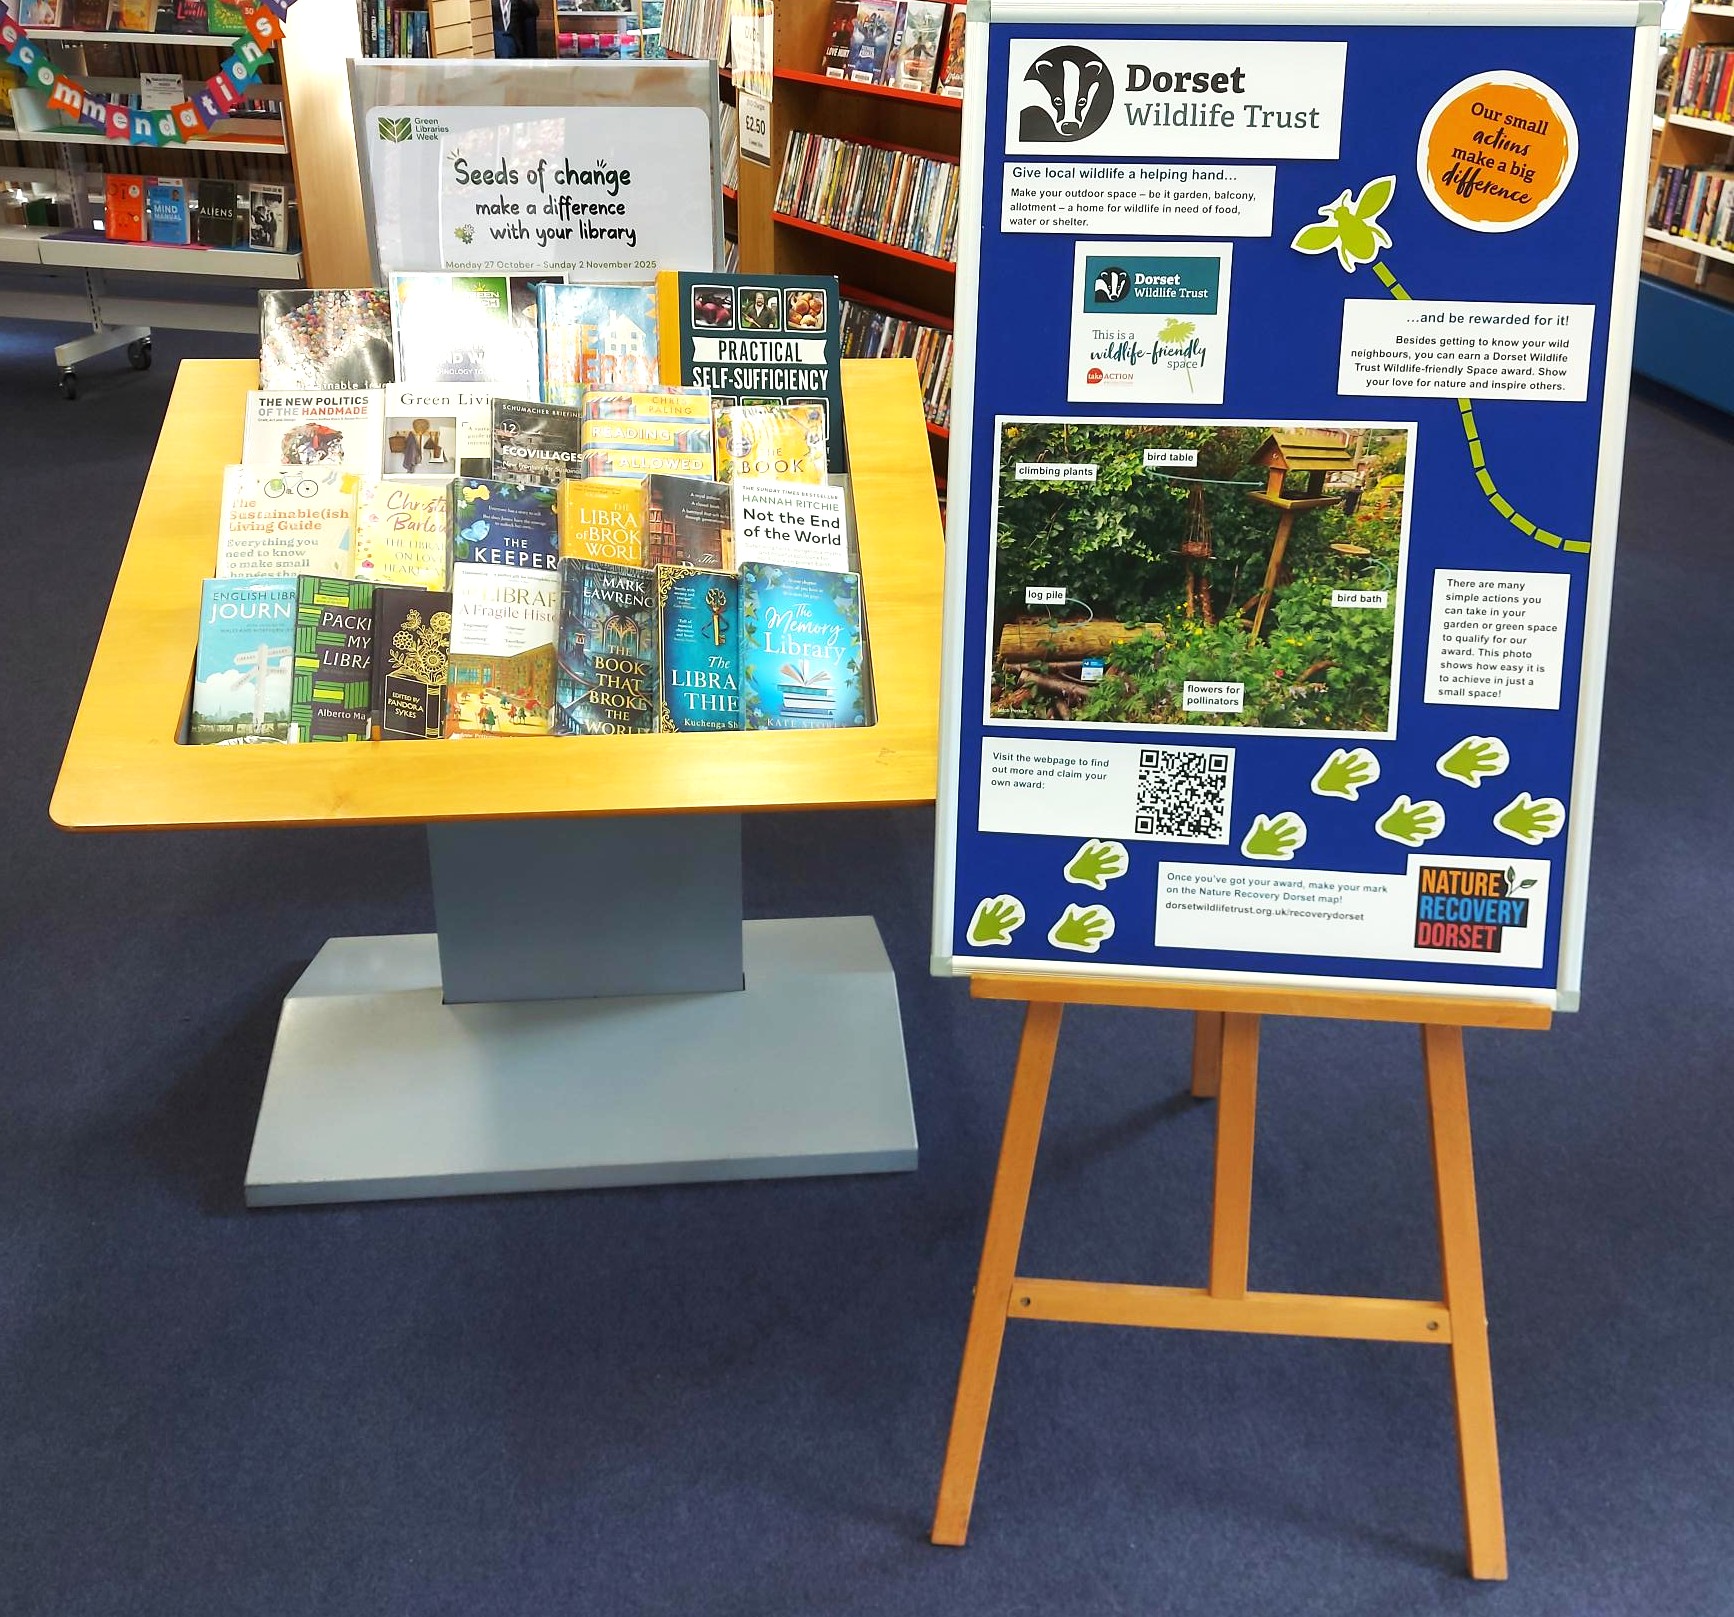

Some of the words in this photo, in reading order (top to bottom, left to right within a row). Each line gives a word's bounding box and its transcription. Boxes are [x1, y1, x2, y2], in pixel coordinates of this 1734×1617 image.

[1125, 64, 1246, 93] Dorset
[414, 117, 439, 125] Green
[1125, 102, 1235, 127] Wildlife
[1243, 105, 1320, 129] Trust
[1471, 102, 1502, 122] Our
[1504, 114, 1549, 136] small
[415, 126, 449, 134] Libraries
[416, 133, 439, 141] Week
[1473, 127, 1530, 156] actions
[1451, 147, 1495, 168] make
[1498, 161, 1506, 172] a
[1510, 161, 1536, 184] big
[454, 157, 518, 186] Seeds
[526, 158, 546, 193] of
[555, 157, 631, 196] change
[1012, 166, 1040, 177] Give
[1045, 167, 1075, 178] local
[1079, 167, 1124, 178] wildlife
[1128, 170, 1135, 179] a
[1140, 168, 1187, 182] helping
[1192, 168, 1236, 180] hand...
[1442, 162, 1532, 204] difference
[1010, 188, 1036, 196] Make
[1039, 190, 1062, 199] your
[1064, 188, 1104, 197] outdoor
[1107, 191, 1136, 200] space
[1148, 189, 1160, 198] be
[1164, 189, 1170, 198] it
[1173, 190, 1210, 200] garden,
[1214, 190, 1255, 201] balcony,
[154, 204, 178, 214] MIND
[200, 206, 234, 218] ALIENS
[476, 195, 519, 216] make
[526, 204, 537, 216] a
[543, 196, 626, 221] difference
[490, 219, 530, 240] with
[535, 226, 573, 247] your
[579, 220, 637, 247] library
[446, 260, 481, 270] Monday
[483, 261, 495, 270] 27
[497, 260, 534, 270] October
[543, 260, 576, 270] Sunday
[578, 261, 585, 270] 2
[586, 260, 632, 270] November
[633, 260, 657, 268] 2025
[1134, 273, 1180, 286] Dorset
[1134, 288, 1176, 298] Wildlife
[1179, 288, 1208, 298] Trust
[1407, 312, 1444, 322] ...and
[1448, 312, 1464, 323] be
[1468, 313, 1530, 324] rewarded
[1534, 314, 1552, 325] for
[1556, 314, 1568, 325] it!
[1092, 330, 1114, 340] This
[1117, 330, 1126, 340] is
[1128, 332, 1135, 340] a
[1395, 335, 1436, 344] Besides
[1439, 336, 1475, 347] getting
[1478, 337, 1488, 346] to
[1491, 337, 1519, 346] know
[1522, 340, 1545, 349] your
[1548, 339, 1569, 347] wild
[718, 340, 802, 362] PRACTICAL
[1090, 338, 1207, 368] wildlife-friendly
[1167, 360, 1198, 370] space
[692, 366, 829, 391] SELF-SUFFICIENCY
[259, 398, 282, 406] THE
[286, 397, 314, 406] NEW
[316, 396, 368, 406] POLITICS
[400, 393, 450, 406] Green
[258, 408, 273, 416] OF
[276, 408, 299, 416] THE
[302, 406, 368, 416] HANDMADE
[502, 404, 550, 416] SCHUMACHER
[649, 406, 692, 415] PALING
[592, 426, 671, 442] READING
[502, 445, 582, 462] ECOVILLAGES
[1148, 452, 1168, 462] bird
[1171, 452, 1194, 462] table
[619, 456, 704, 472] ALLOWED
[742, 460, 804, 474] BOOK
[1019, 466, 1058, 478] climbing
[1064, 466, 1094, 478] plants
[742, 494, 792, 507] HANNAH
[796, 500, 840, 512] RITCHIE
[744, 508, 774, 522] Not
[779, 512, 805, 526] the
[810, 515, 840, 529] End
[230, 522, 274, 534] Living
[278, 520, 322, 530] Guide
[504, 537, 528, 549] THE
[744, 526, 760, 538] of
[764, 527, 790, 541] the
[794, 530, 841, 546] World
[475, 547, 557, 570] KEEPER
[602, 576, 646, 594] MARK
[1446, 578, 1475, 587] There
[1497, 582, 1525, 591] many
[214, 592, 266, 600] ENGLISH
[1028, 591, 1042, 602] log
[1044, 590, 1064, 601] pile
[1337, 593, 1358, 604] bird
[1360, 593, 1382, 604] bath
[792, 603, 812, 618] The
[764, 606, 845, 646] Memory
[348, 635, 372, 649] MY
[763, 631, 847, 666] Library
[608, 644, 632, 656] THE
[594, 656, 646, 676] BOOK
[708, 656, 731, 669] The
[596, 673, 644, 696] THAT
[672, 670, 738, 691] LIBRA
[1186, 684, 1226, 695] flowers
[1227, 685, 1240, 694] for
[392, 692, 412, 702] EDITED
[589, 689, 647, 711] BROKE
[1186, 694, 1239, 706] pollinators
[388, 698, 424, 713] PANDORA
[318, 708, 351, 719] Alberto
[395, 708, 418, 719] SYKES
[605, 708, 630, 721] THE
[684, 718, 726, 730] Kuchenga
[992, 752, 1013, 760] Visit
[1016, 753, 1030, 762] the
[1033, 755, 1076, 766] webpage
[1091, 758, 1109, 767] find
[1421, 868, 1501, 897] NATURE
[1165, 901, 1363, 920] dorsetwildlifetrust.org.uk/recoverydorset
[1420, 896, 1526, 926] RECOVERY
[1418, 922, 1498, 950] DORSET
